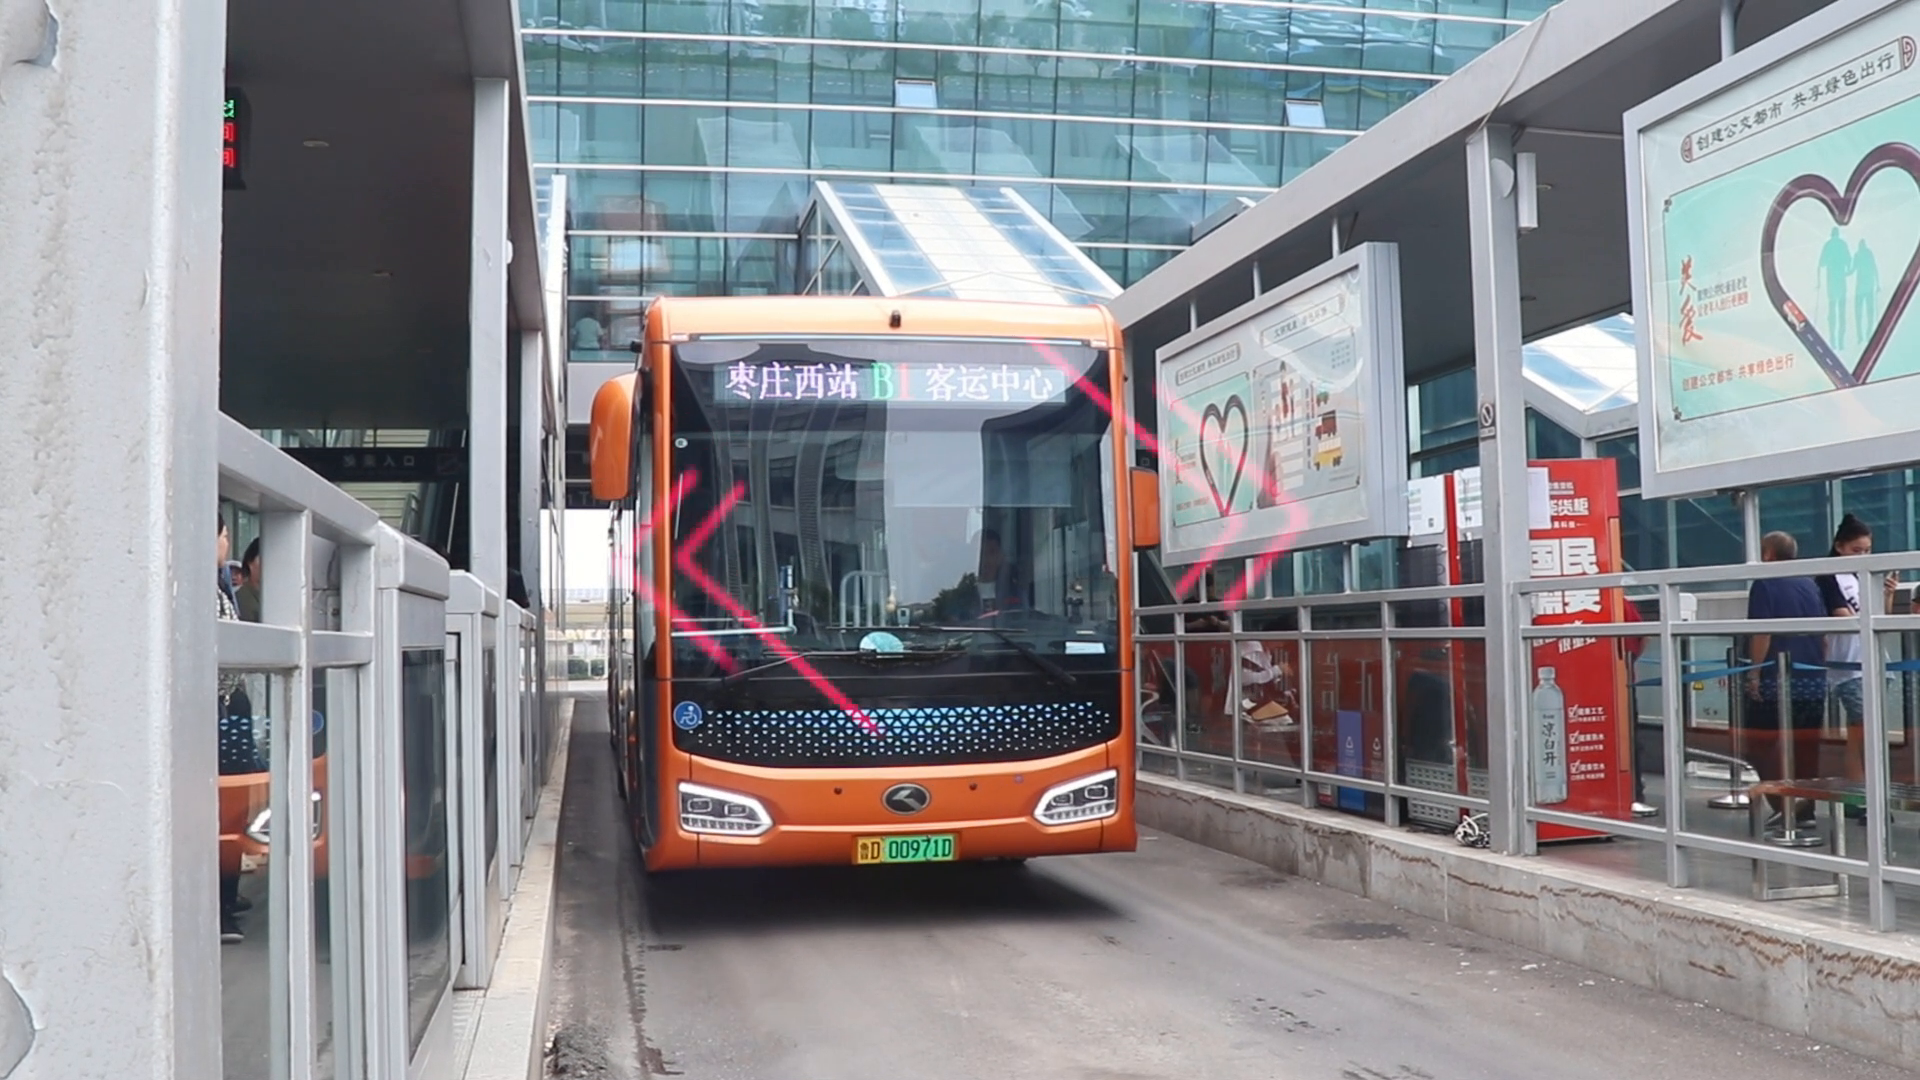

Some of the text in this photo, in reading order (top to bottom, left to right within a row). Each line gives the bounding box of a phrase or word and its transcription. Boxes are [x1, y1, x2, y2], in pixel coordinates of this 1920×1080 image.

[1695, 51, 1895, 152] 创建公交都市 共享绿色出行
[725, 360, 1054, 401] 枣庄西站 B1 客运中心
[1530, 537, 1600, 576] 国民
[888, 838, 953, 859] 00971D
